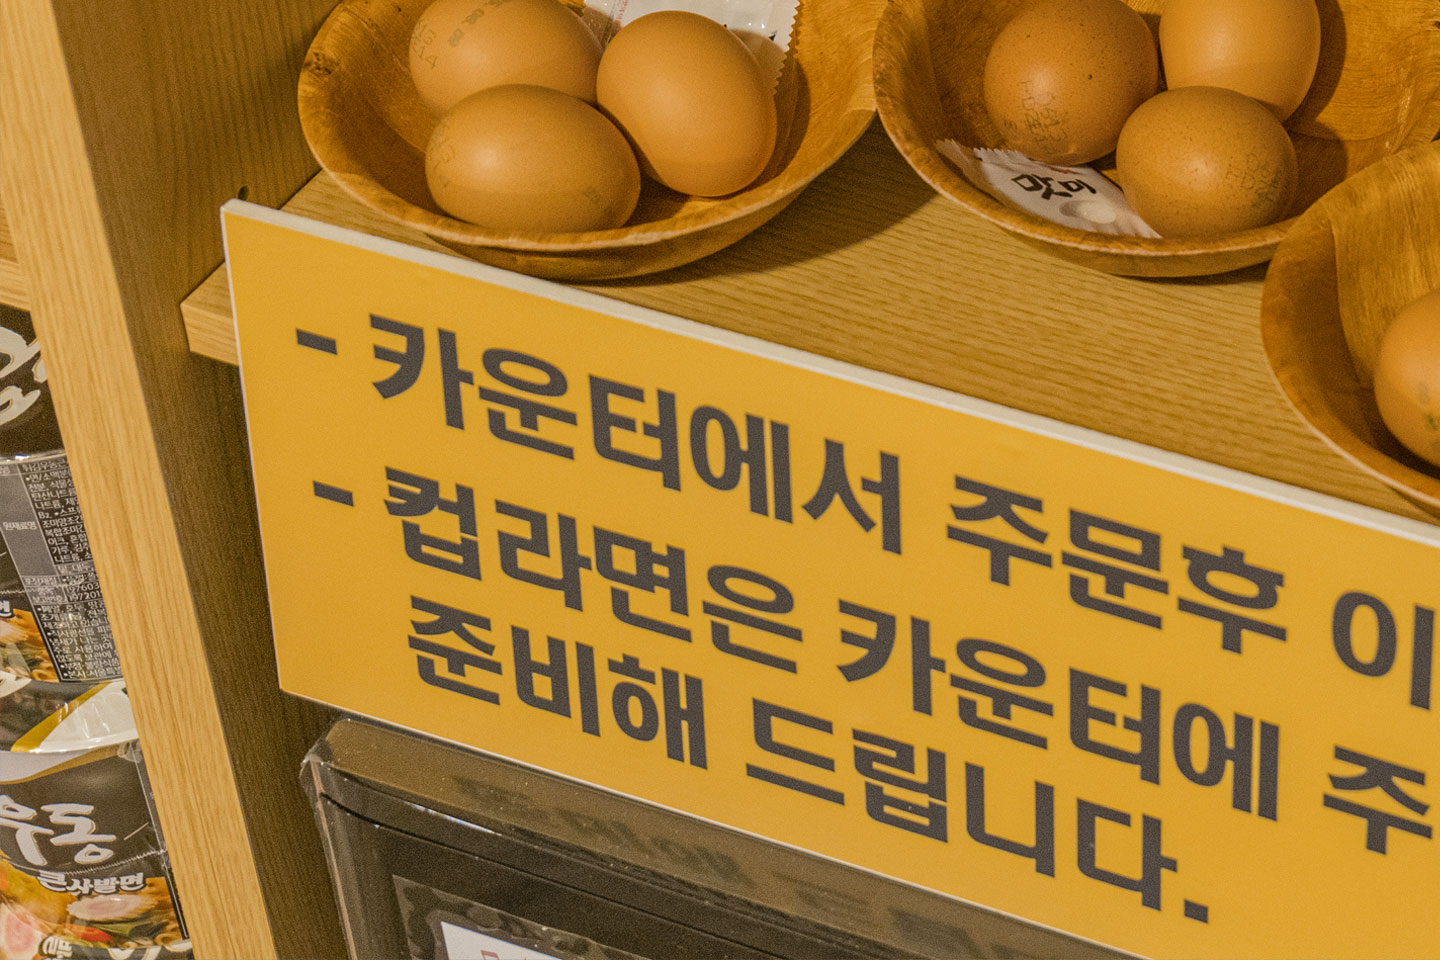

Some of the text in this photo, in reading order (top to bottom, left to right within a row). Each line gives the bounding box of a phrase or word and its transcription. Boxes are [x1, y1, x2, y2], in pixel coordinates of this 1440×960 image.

[370, 314, 901, 555] 카운터에서
[947, 476, 1286, 654] 주문후
[384, 467, 803, 674] 컵라면은
[837, 600, 1279, 821] 카운터에
[408, 596, 1208, 923] 준비해 드립니다.
